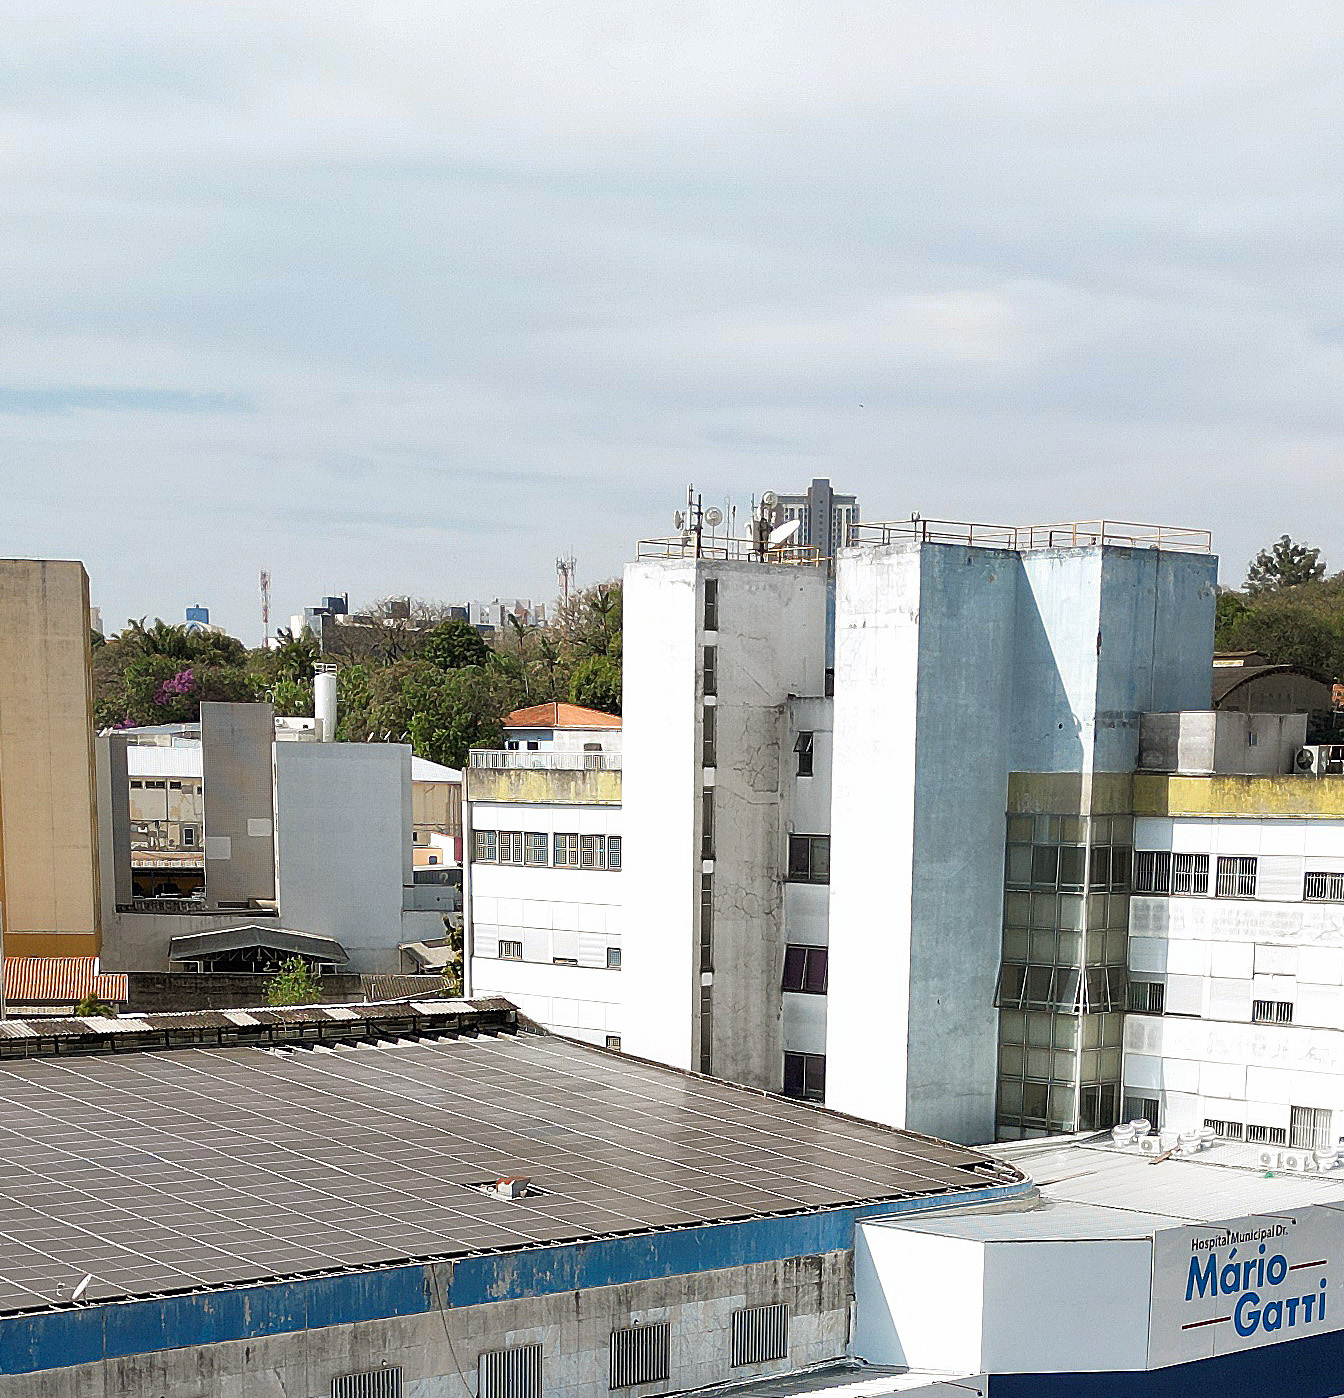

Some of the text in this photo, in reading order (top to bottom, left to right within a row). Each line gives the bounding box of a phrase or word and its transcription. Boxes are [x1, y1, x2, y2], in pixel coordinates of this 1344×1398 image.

[1191, 1224, 1288, 1251] Hospital Municipal Dr.
[1185, 1244, 1287, 1301] Mário
